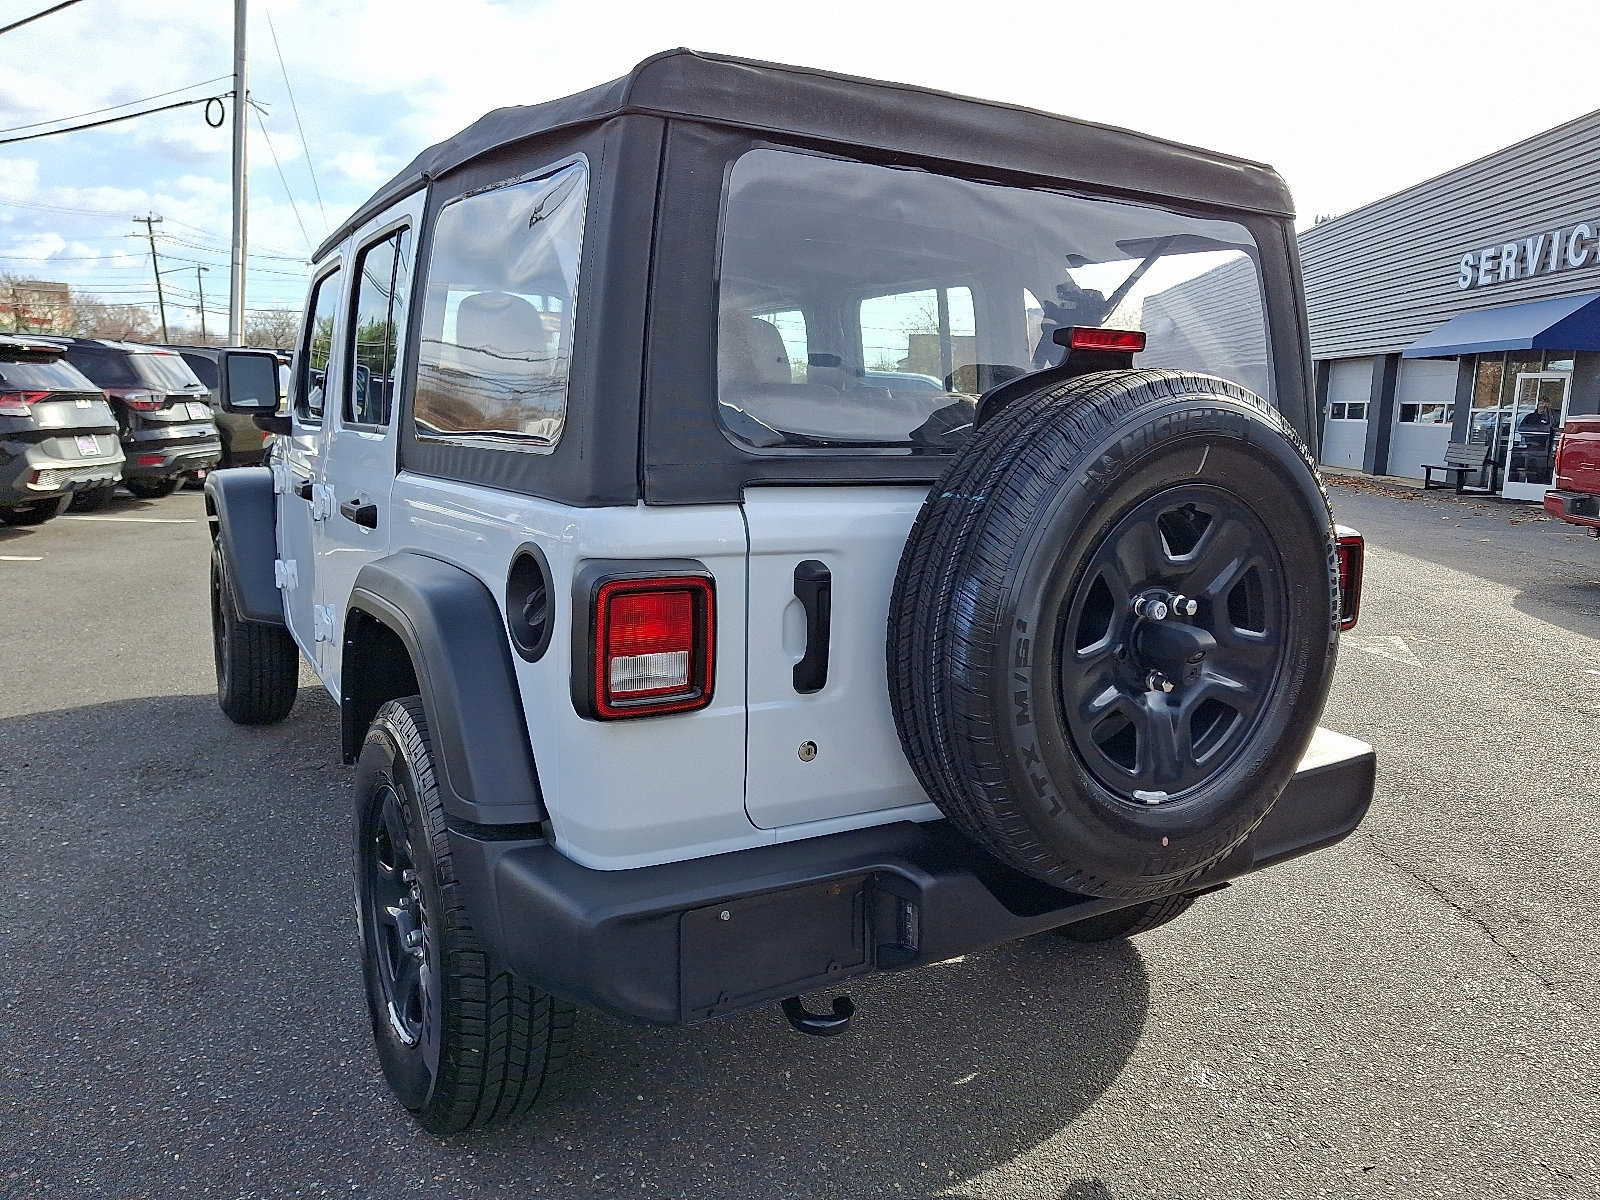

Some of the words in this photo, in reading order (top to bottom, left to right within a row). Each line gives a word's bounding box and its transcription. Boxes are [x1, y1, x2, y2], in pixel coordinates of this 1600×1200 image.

[1458, 222, 1600, 290] SERVIC
[1119, 409, 1246, 457] MICHELIN
[1021, 742, 1064, 817] LTX
